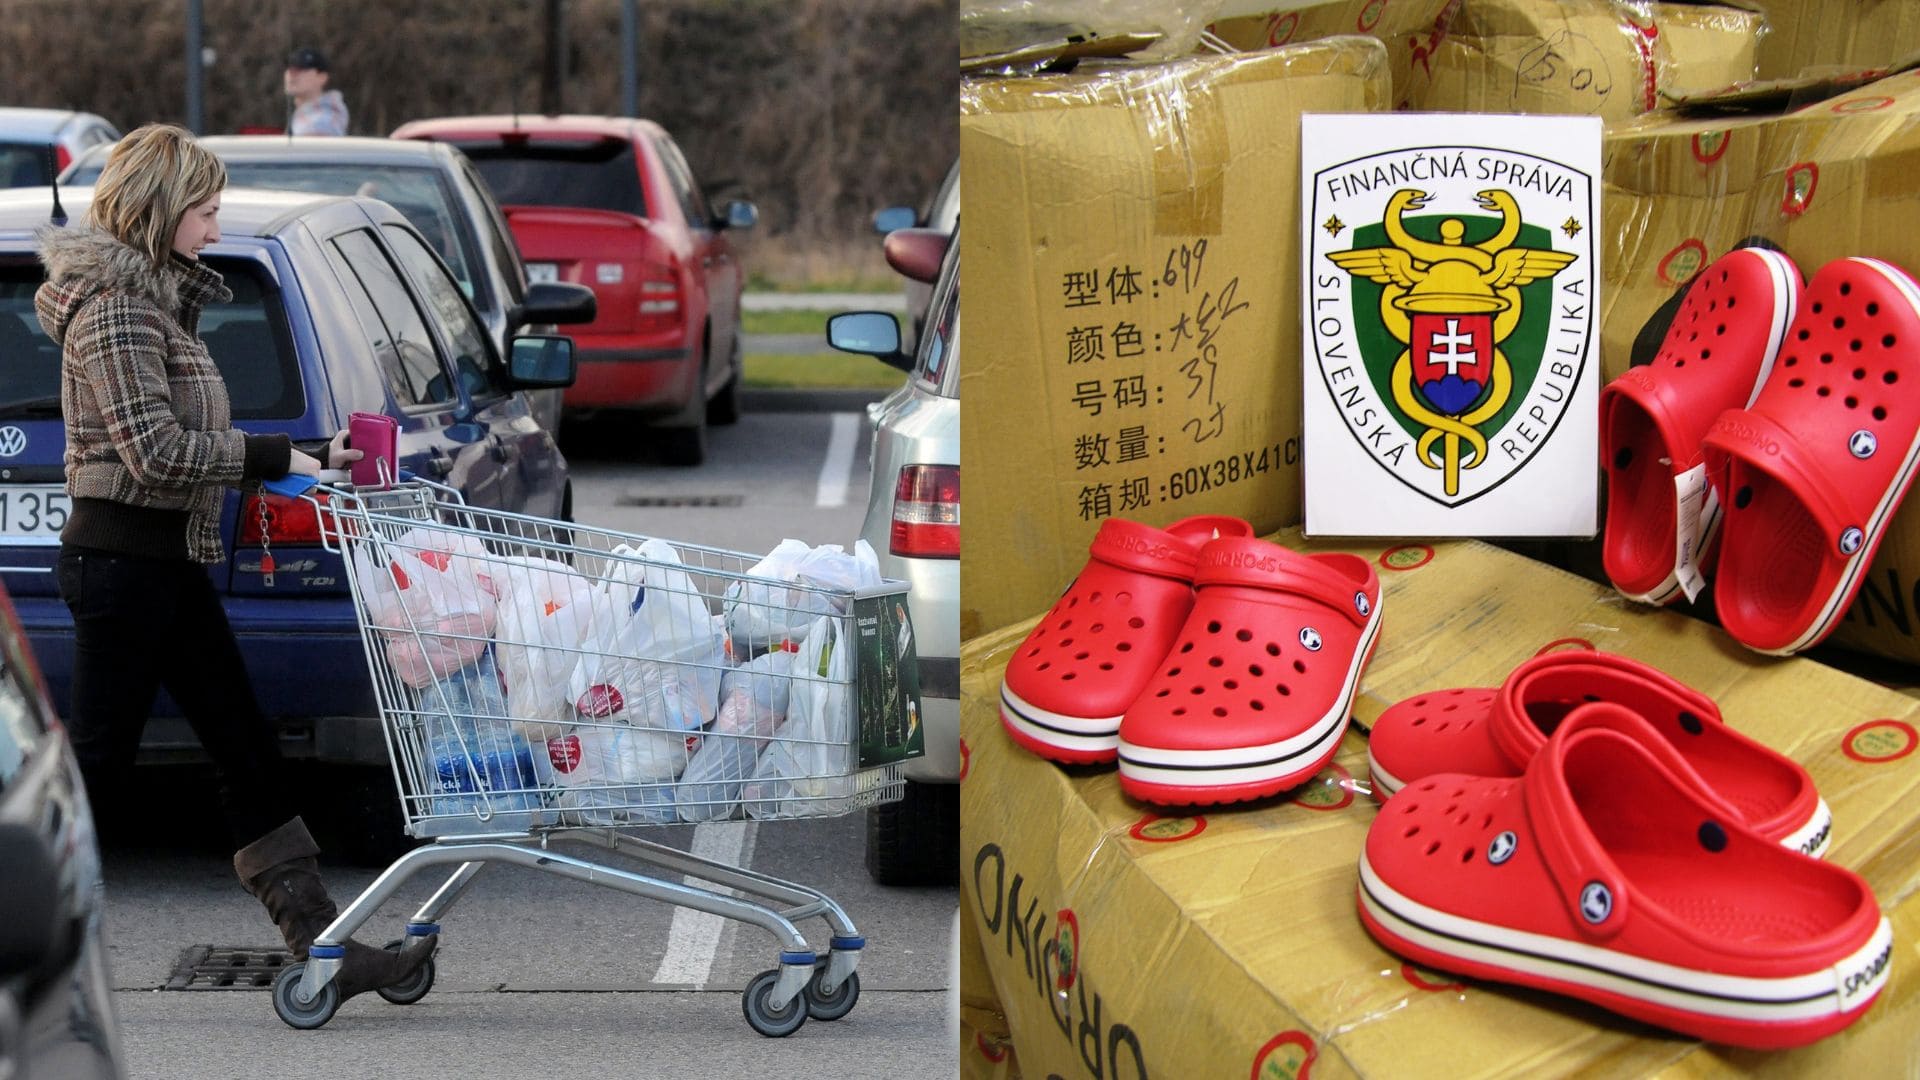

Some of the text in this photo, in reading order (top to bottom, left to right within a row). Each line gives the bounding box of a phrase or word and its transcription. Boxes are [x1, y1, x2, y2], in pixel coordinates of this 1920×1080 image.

[1327, 151, 1573, 202] FINANČNÁ SPRÁVA
[1163, 238, 1208, 293] 699
[1179, 344, 1217, 405] 39
[1317, 274, 1585, 467] SLOVENSKÁ REPUBLIKA
[1170, 436, 1301, 500] 60X38X41C
